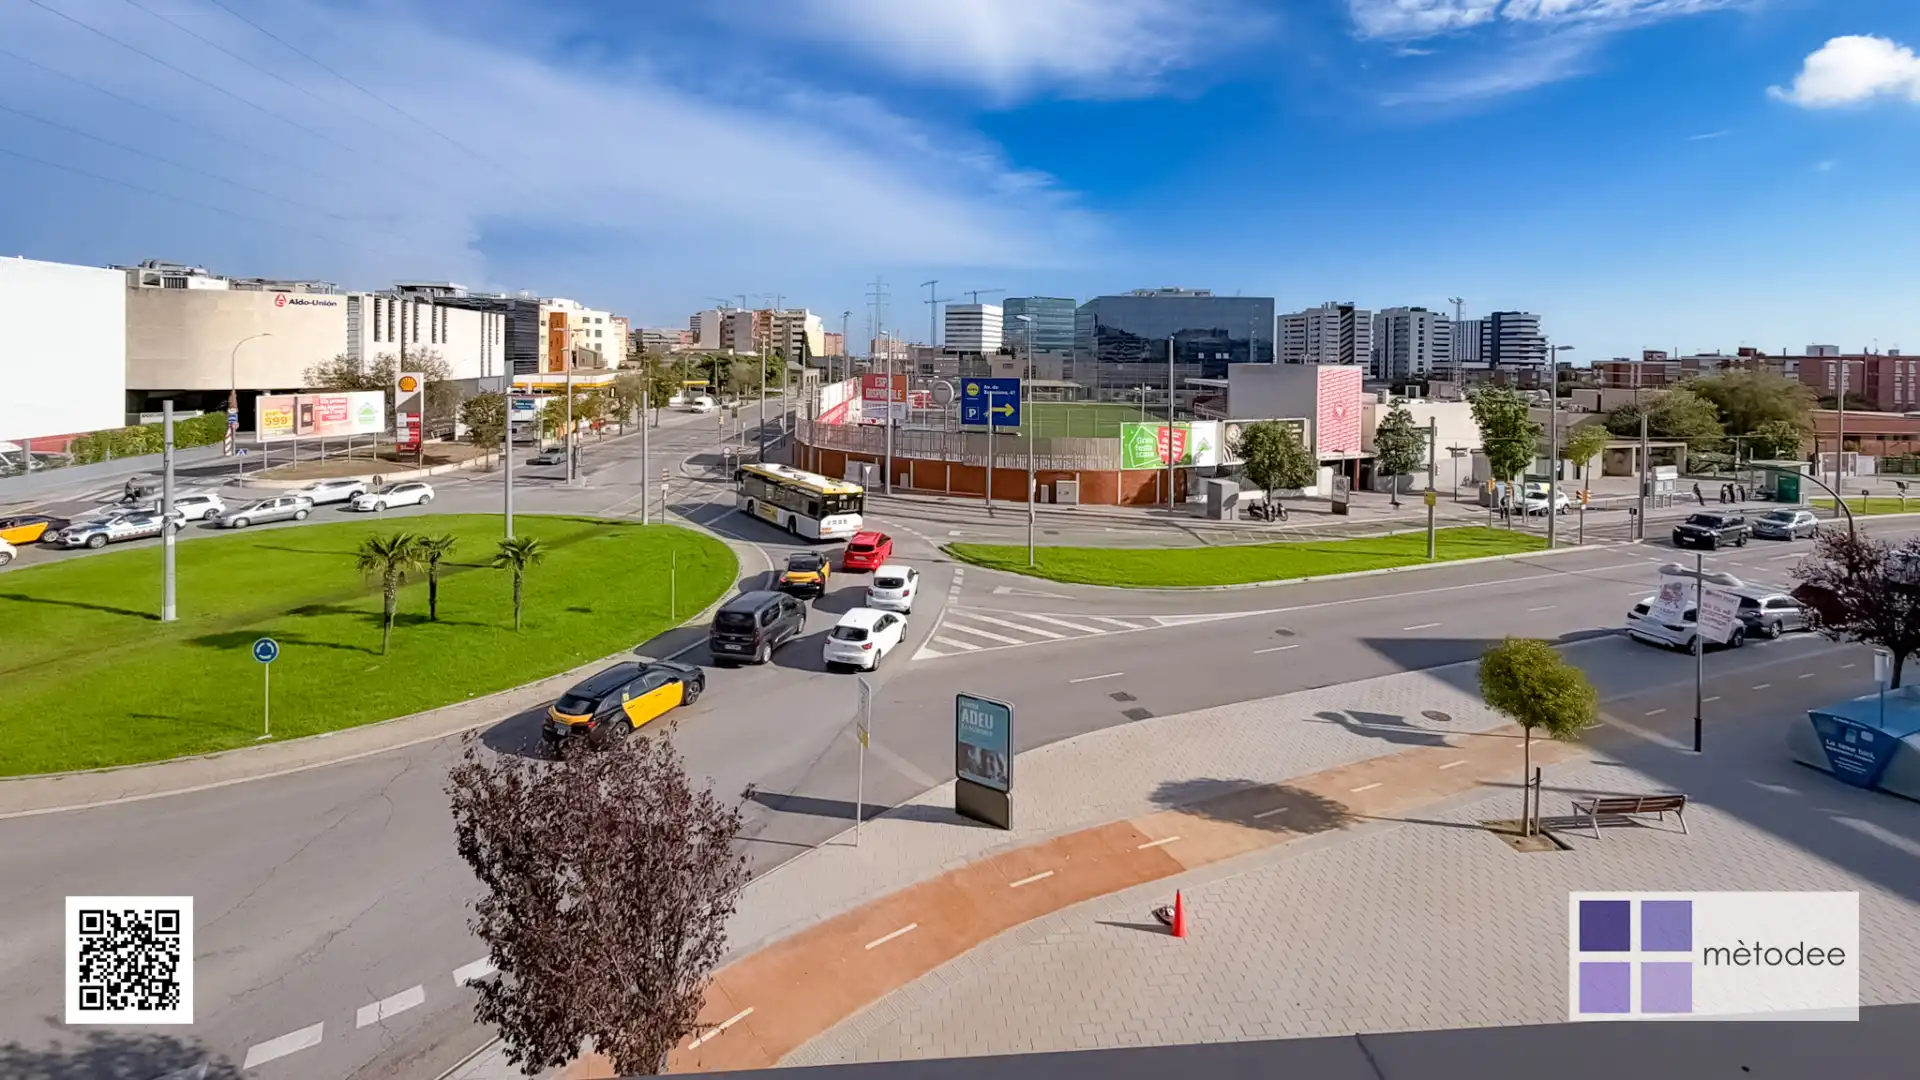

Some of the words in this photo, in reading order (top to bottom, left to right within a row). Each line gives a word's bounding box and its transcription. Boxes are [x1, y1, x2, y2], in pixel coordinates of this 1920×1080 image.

[288, 298, 337, 307] Aldo-Unión
[263, 416, 288, 426] 599
[961, 708, 994, 730] ADEU
